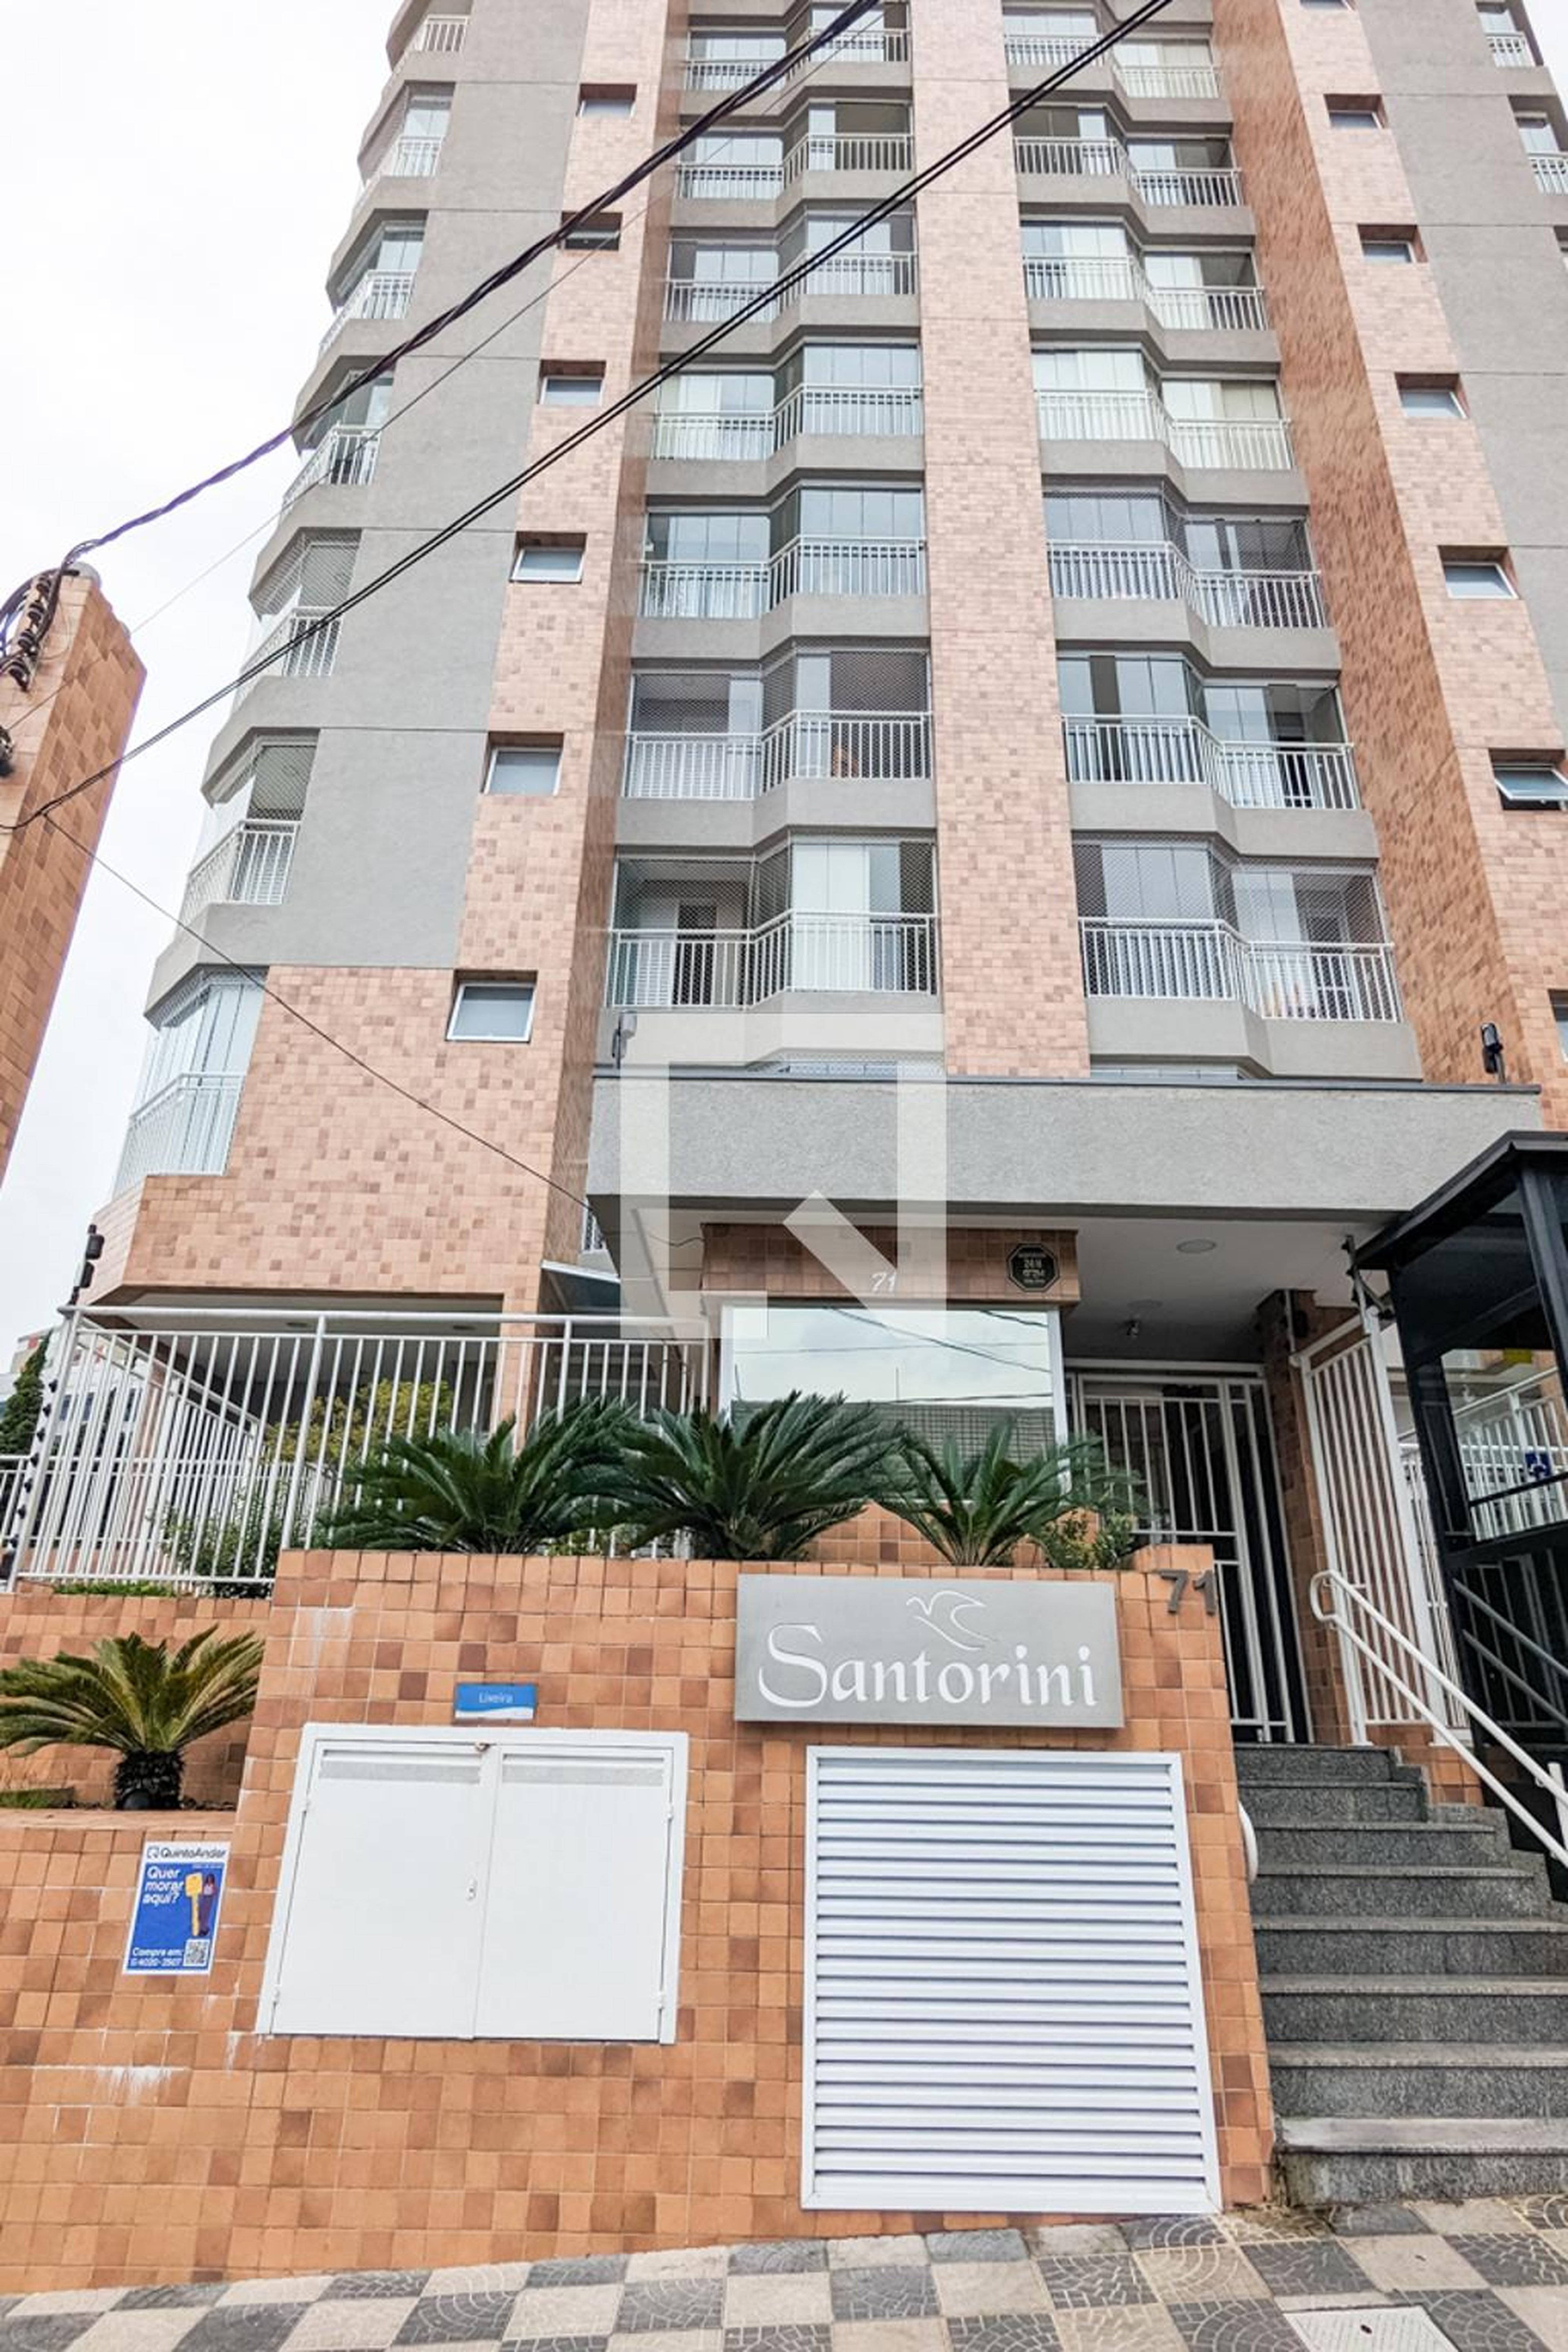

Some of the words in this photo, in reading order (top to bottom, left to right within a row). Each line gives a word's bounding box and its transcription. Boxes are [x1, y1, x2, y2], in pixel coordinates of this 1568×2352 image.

[872, 1272, 896, 1292] 71
[1160, 1569, 1216, 1615] 71
[758, 1622, 1098, 1708] Santorini
[160, 1847, 226, 1858] QuintoAndar
[147, 1865, 181, 1879] Quer
[145, 1880, 184, 1892] morar
[143, 1892, 180, 1907] aqui?
